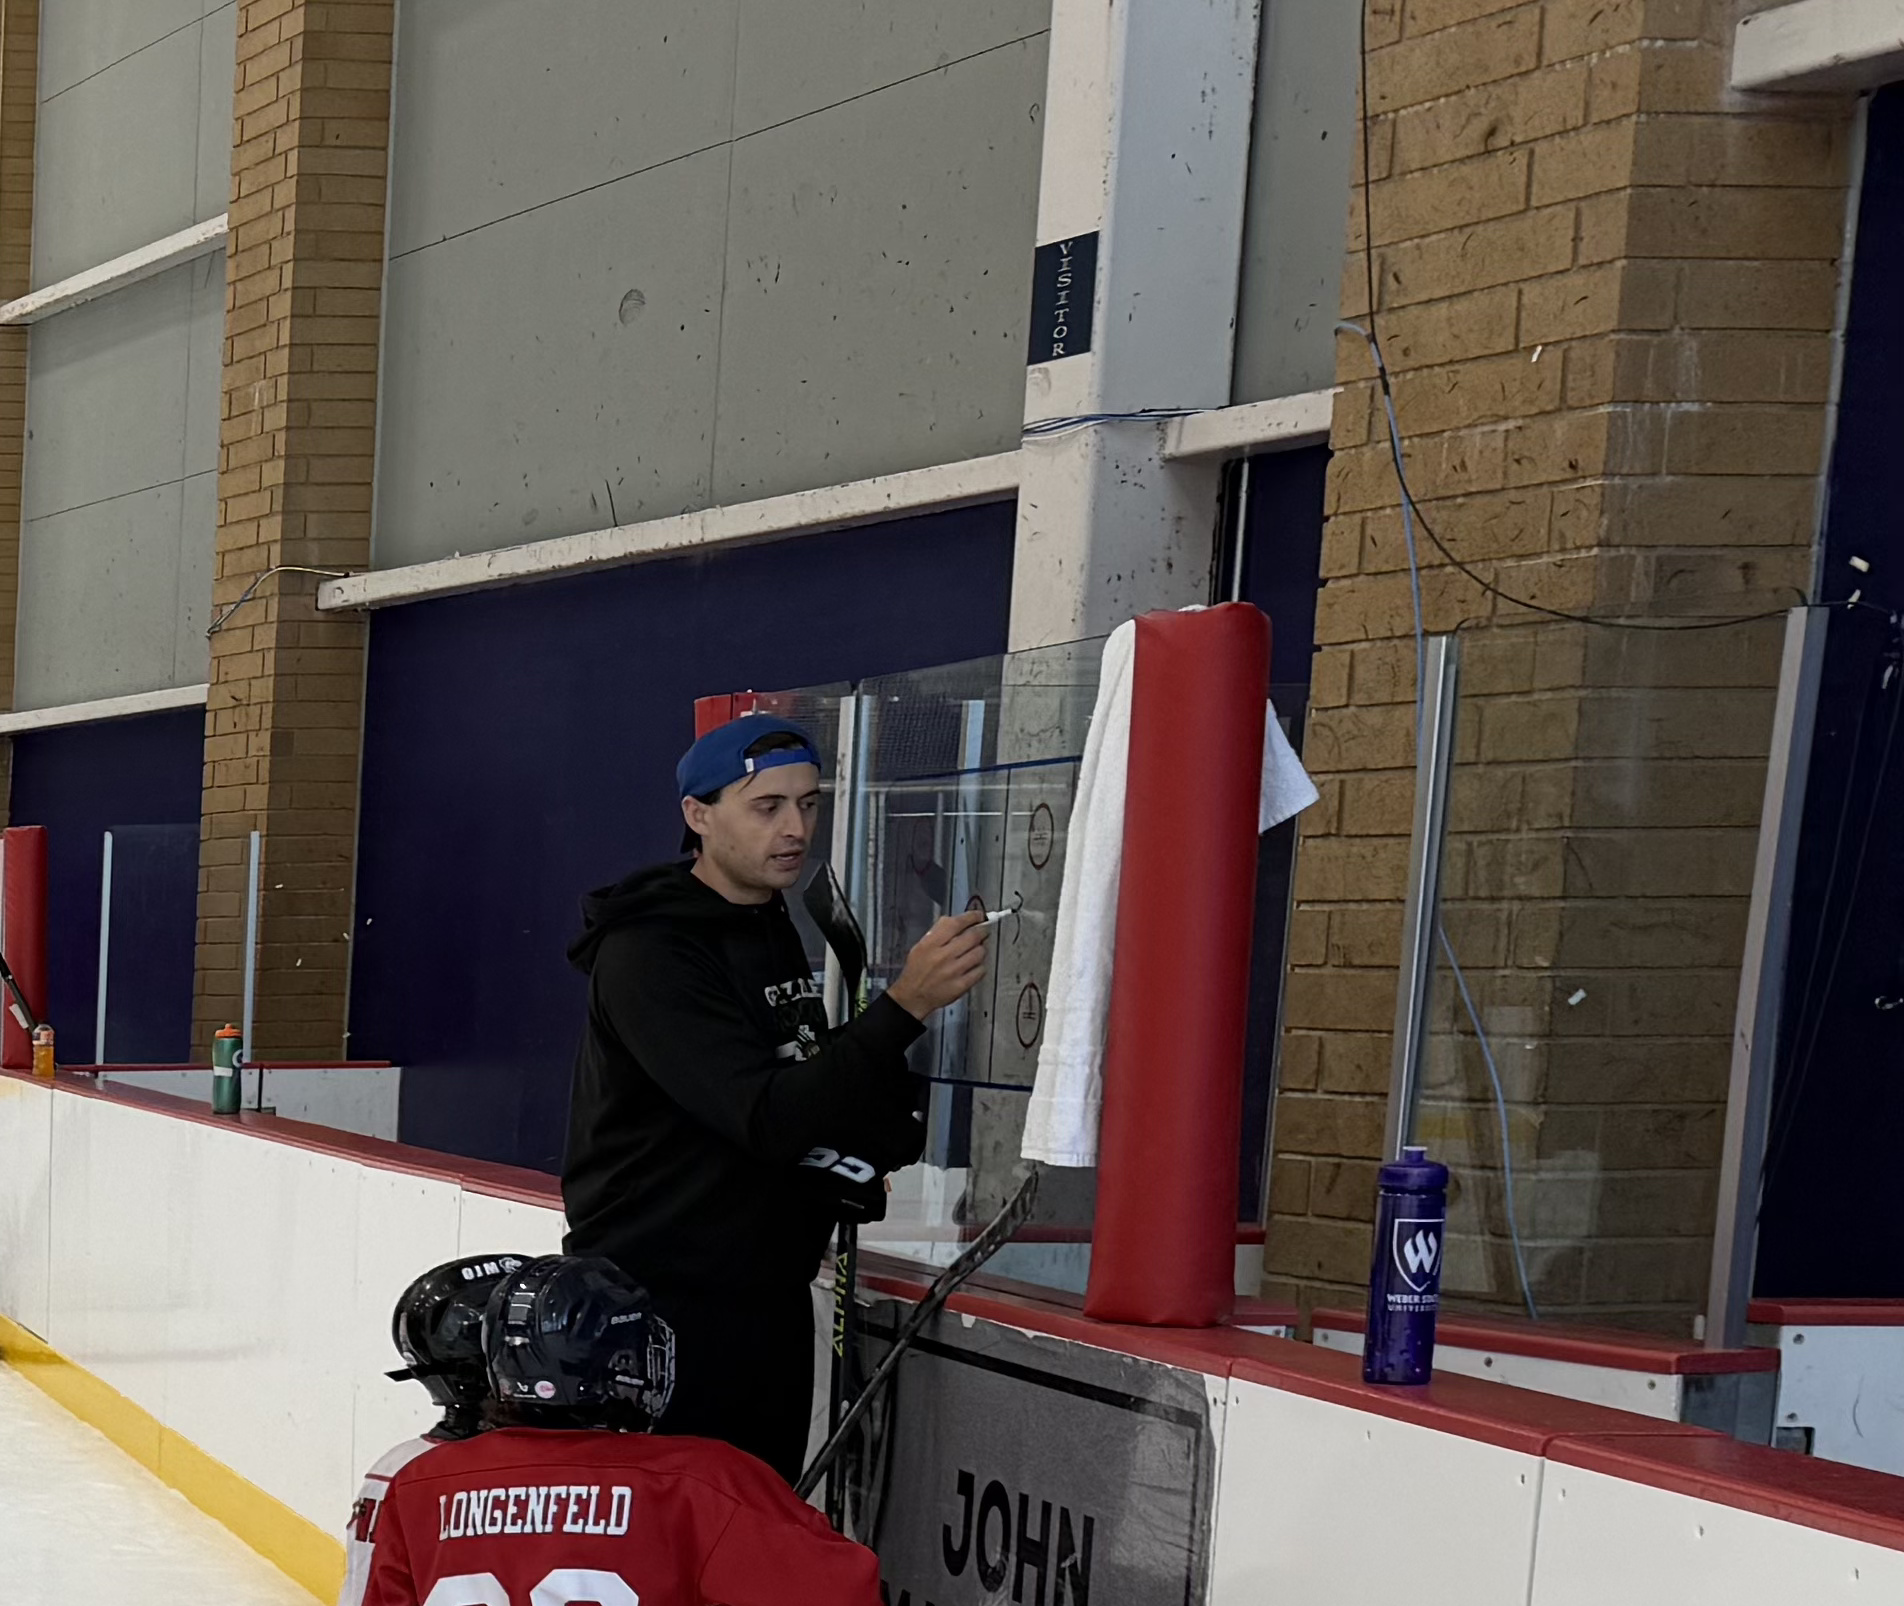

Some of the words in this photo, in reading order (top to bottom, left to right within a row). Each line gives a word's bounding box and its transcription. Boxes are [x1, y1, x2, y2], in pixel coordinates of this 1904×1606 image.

[1052, 241, 1074, 357] VISITOR
[1387, 1293, 1421, 1304] WEBER
[438, 1485, 633, 1541] LONGENFELD
